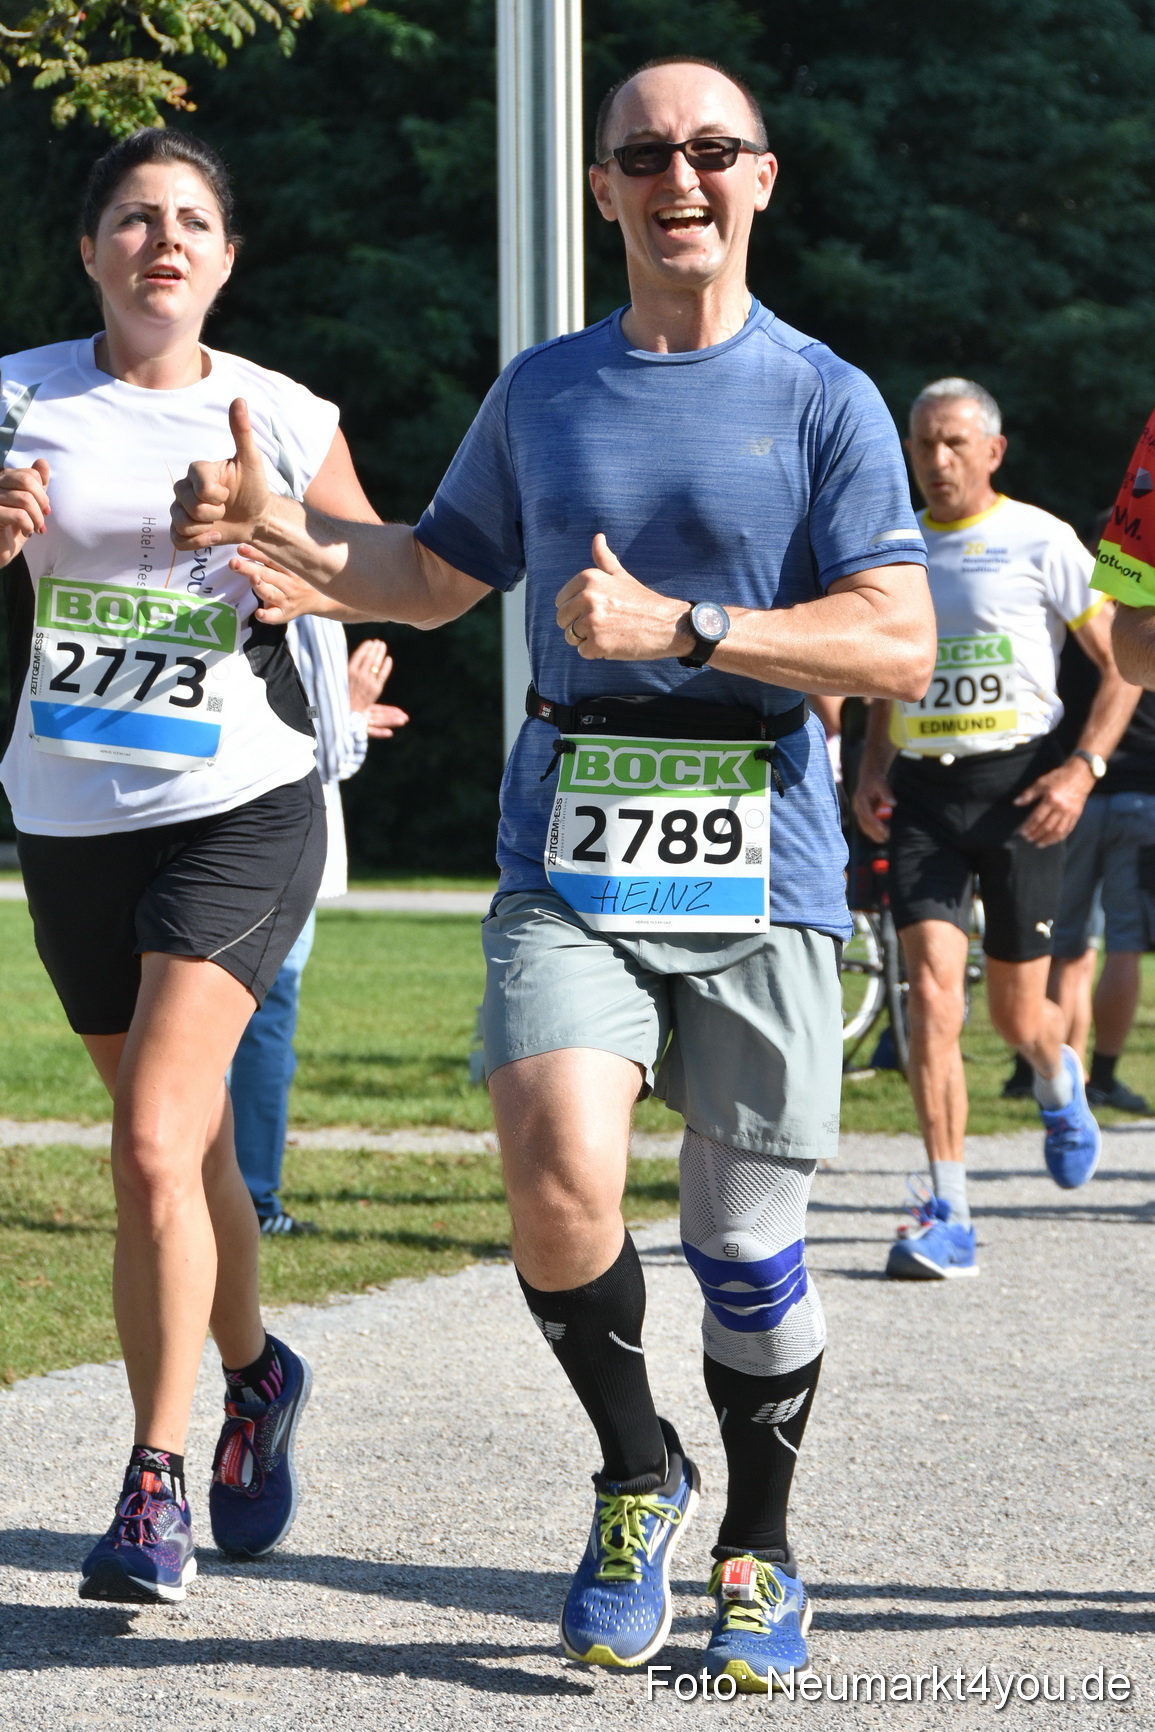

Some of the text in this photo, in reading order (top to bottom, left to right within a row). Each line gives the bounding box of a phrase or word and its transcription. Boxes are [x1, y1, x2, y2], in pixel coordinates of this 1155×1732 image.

[141, 516, 157, 550] Hotel
[52, 586, 221, 643] BOCK
[936, 641, 1002, 665] OCK
[50, 641, 207, 708] 2773
[920, 673, 1003, 709] 209
[920, 716, 997, 736] EDMUND
[571, 746, 751, 789] BOCK
[572, 805, 743, 865] 2789
